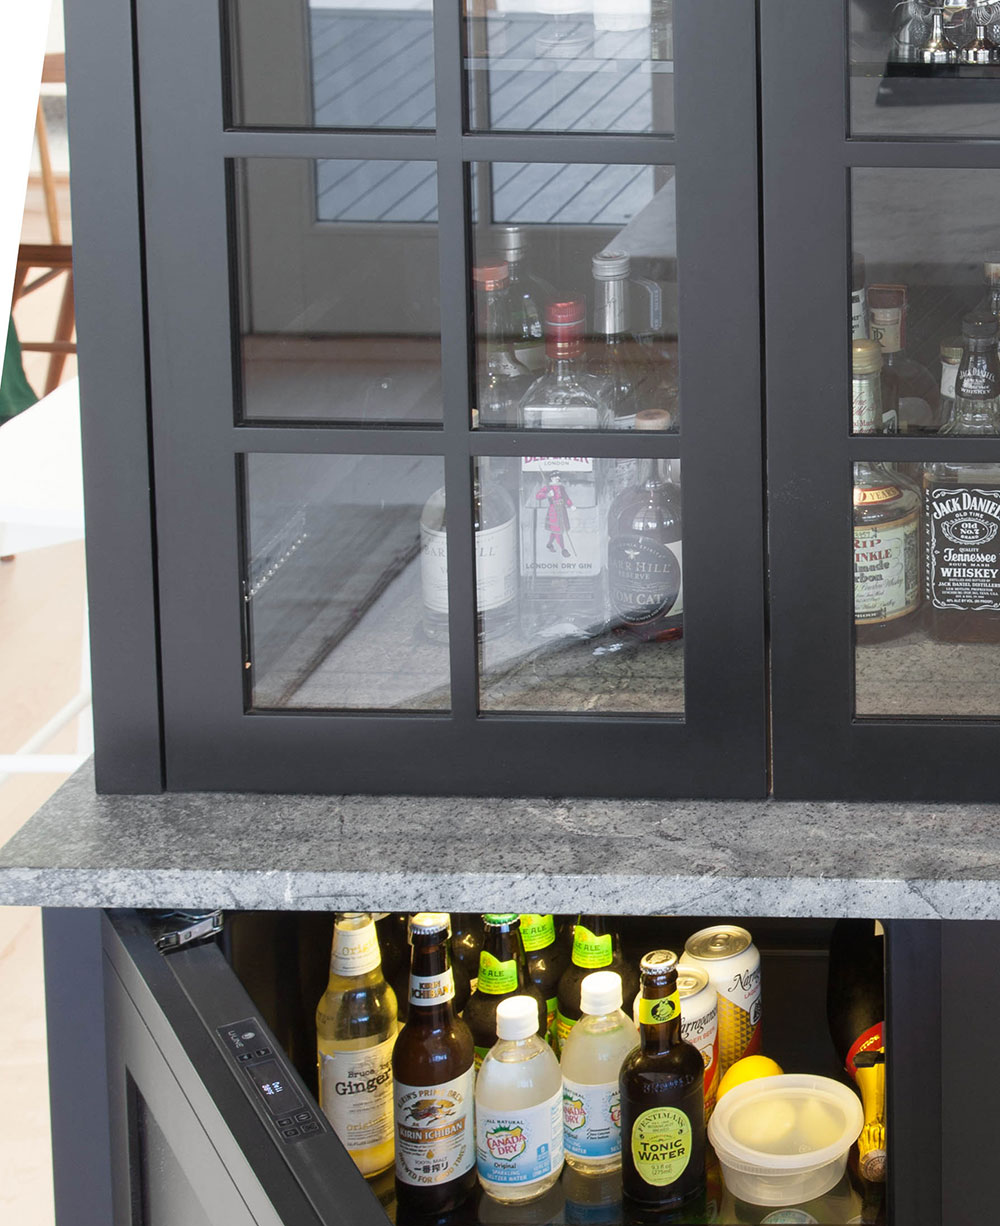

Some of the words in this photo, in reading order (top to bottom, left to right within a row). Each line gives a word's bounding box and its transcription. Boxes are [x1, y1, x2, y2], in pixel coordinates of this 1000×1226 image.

[932, 497, 961, 519] JACK
[855, 549, 892, 562] INKLE
[944, 548, 996, 562] Tennessee
[940, 568, 999, 578] WHISKEY
[636, 593, 663, 605] CAT
[348, 1069, 375, 1078] Bruce
[335, 1067, 391, 1096] Ginger
[400, 1128, 422, 1140] KIRIN
[425, 1121, 463, 1140] ICHIBAN
[487, 1132, 527, 1151] CANADA
[641, 1139, 682, 1151] TONIC
[498, 1144, 517, 1156] DRY
[638, 1147, 685, 1161] WATER
[494, 1162, 517, 1170] Original
[418, 1175, 433, 1183] FOR
